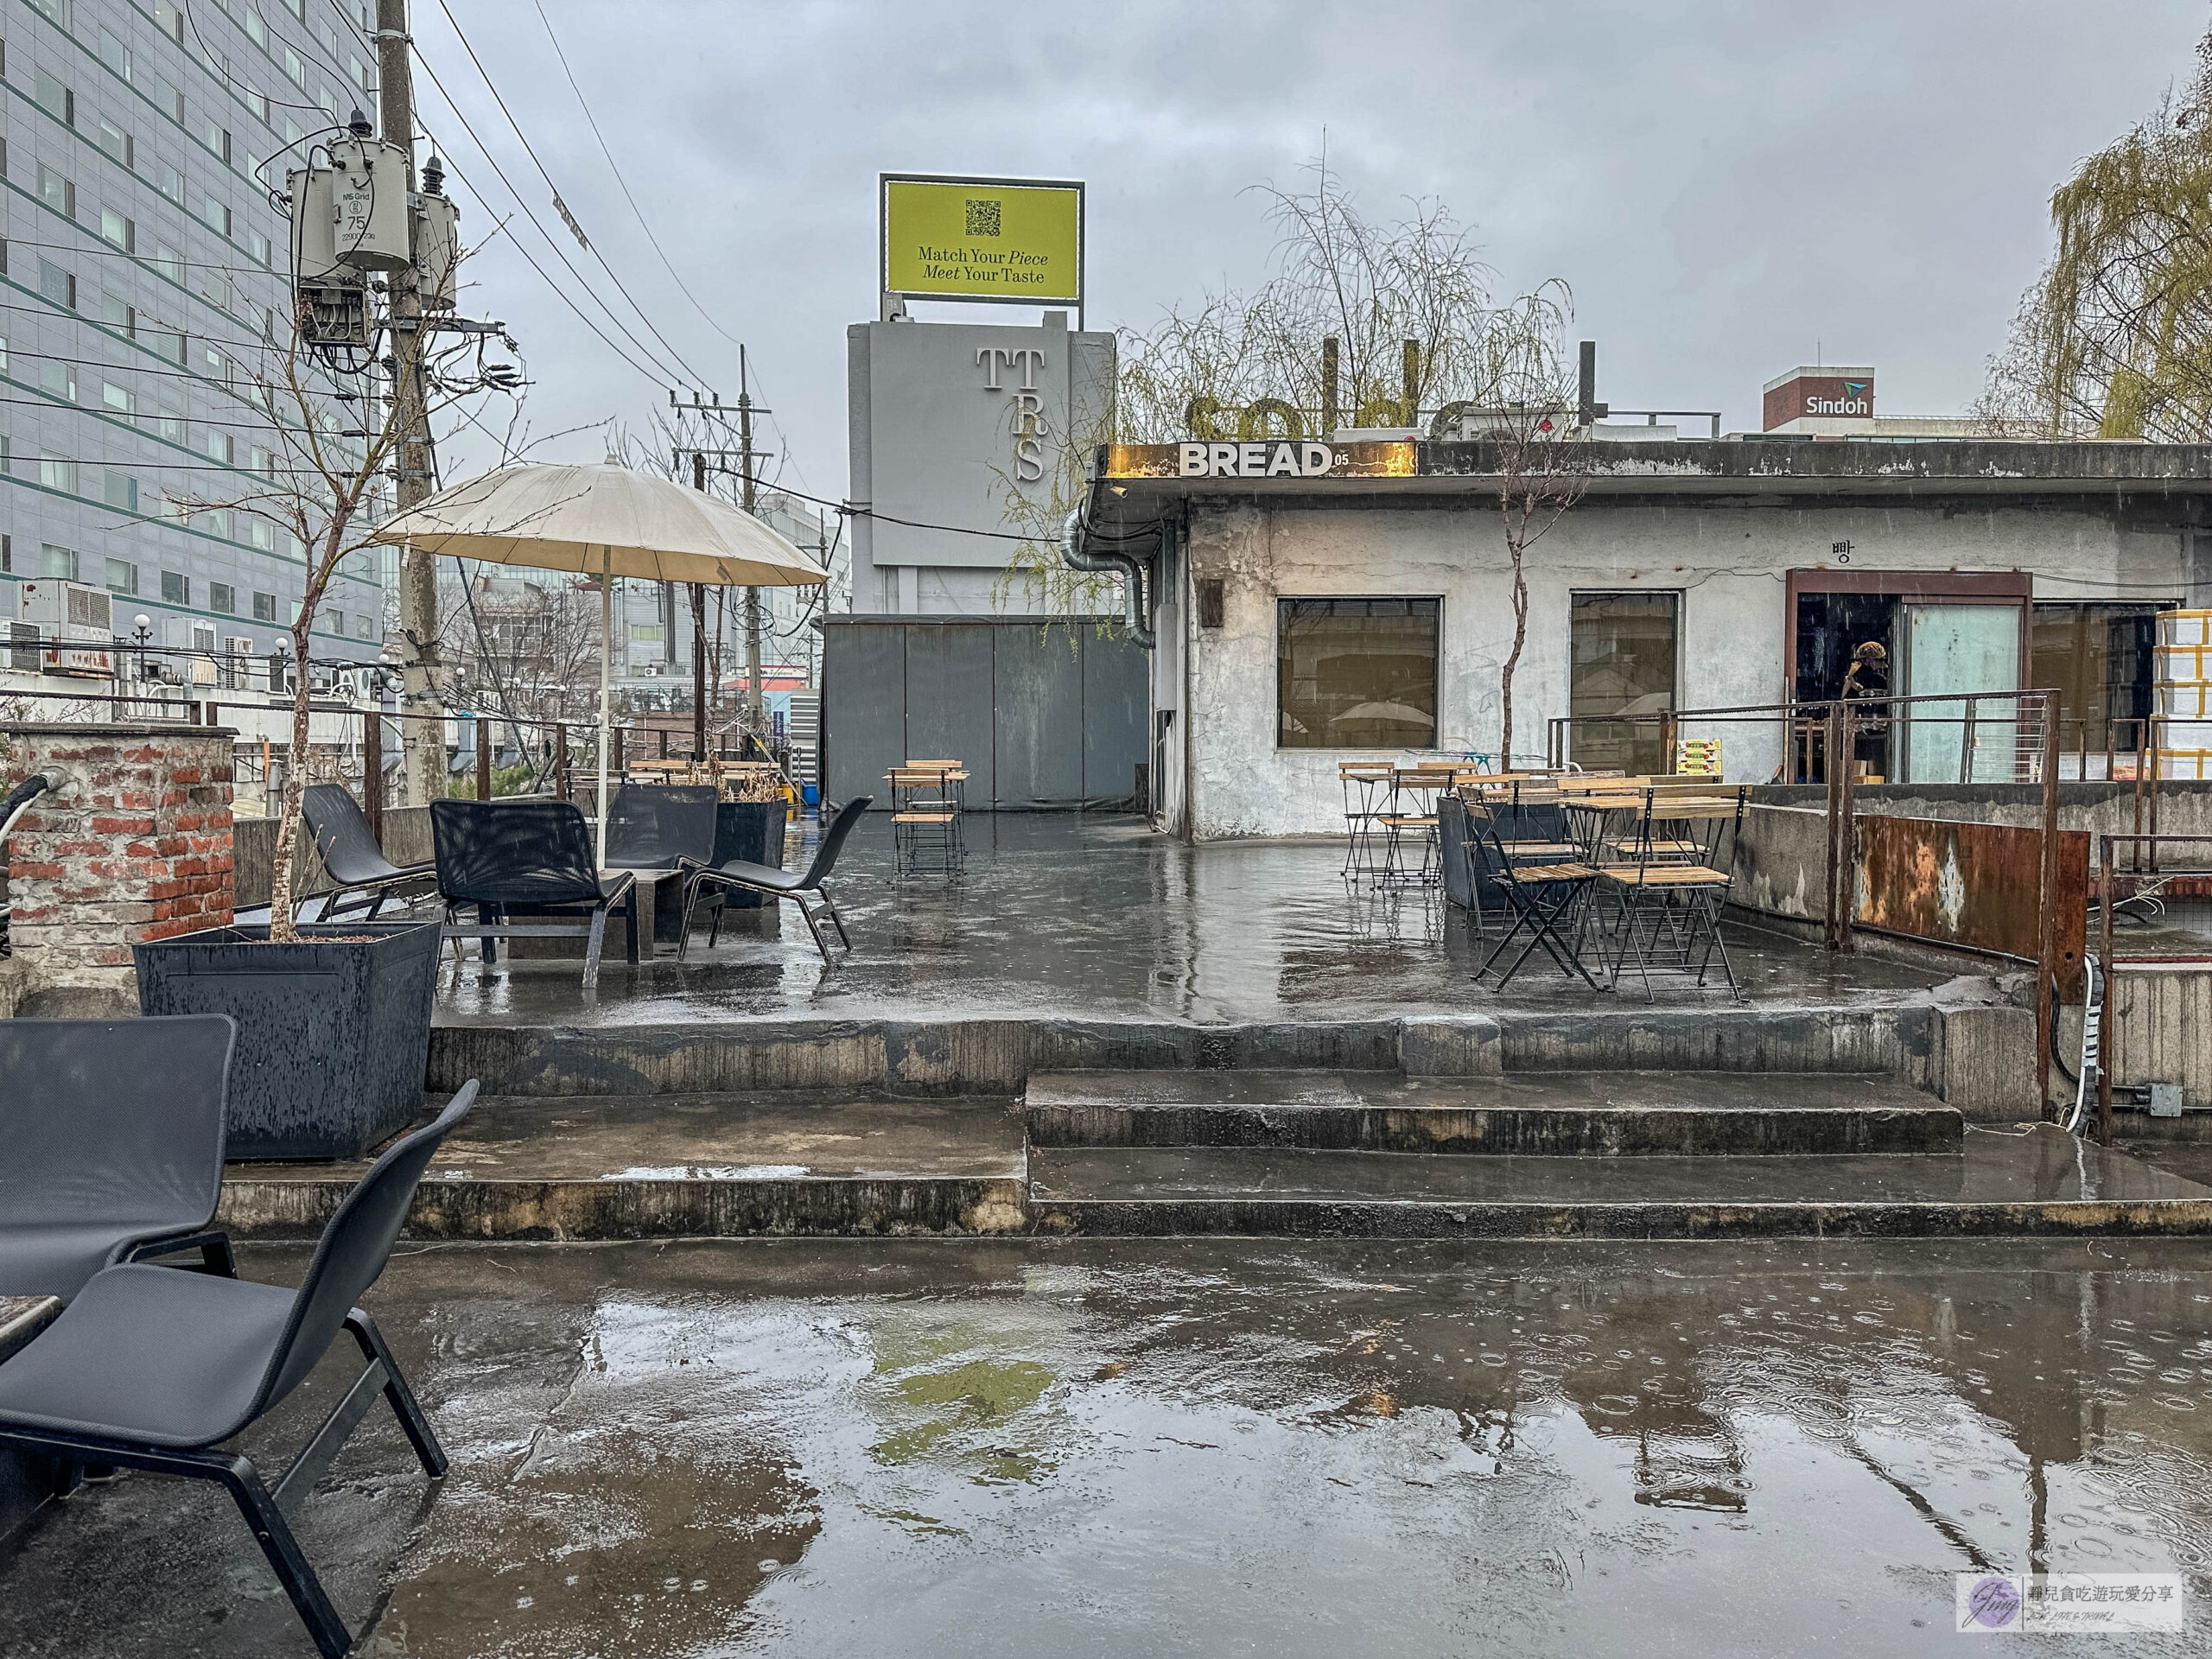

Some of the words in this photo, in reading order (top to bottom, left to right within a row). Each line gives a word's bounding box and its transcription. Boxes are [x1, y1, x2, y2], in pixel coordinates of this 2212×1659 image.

[347, 216, 365, 230] 75
[918, 245, 968, 262] Match
[970, 248, 1006, 264] Your
[1007, 250, 1048, 266] Piece
[922, 264, 961, 280] Meet
[963, 266, 999, 282] Your
[1001, 268, 1045, 283] Taste
[1806, 396, 1868, 415] Sindoh
[1179, 442, 1333, 477] BREAD
[1334, 454, 1350, 467] 05
[1832, 539, 1855, 564] 빵
